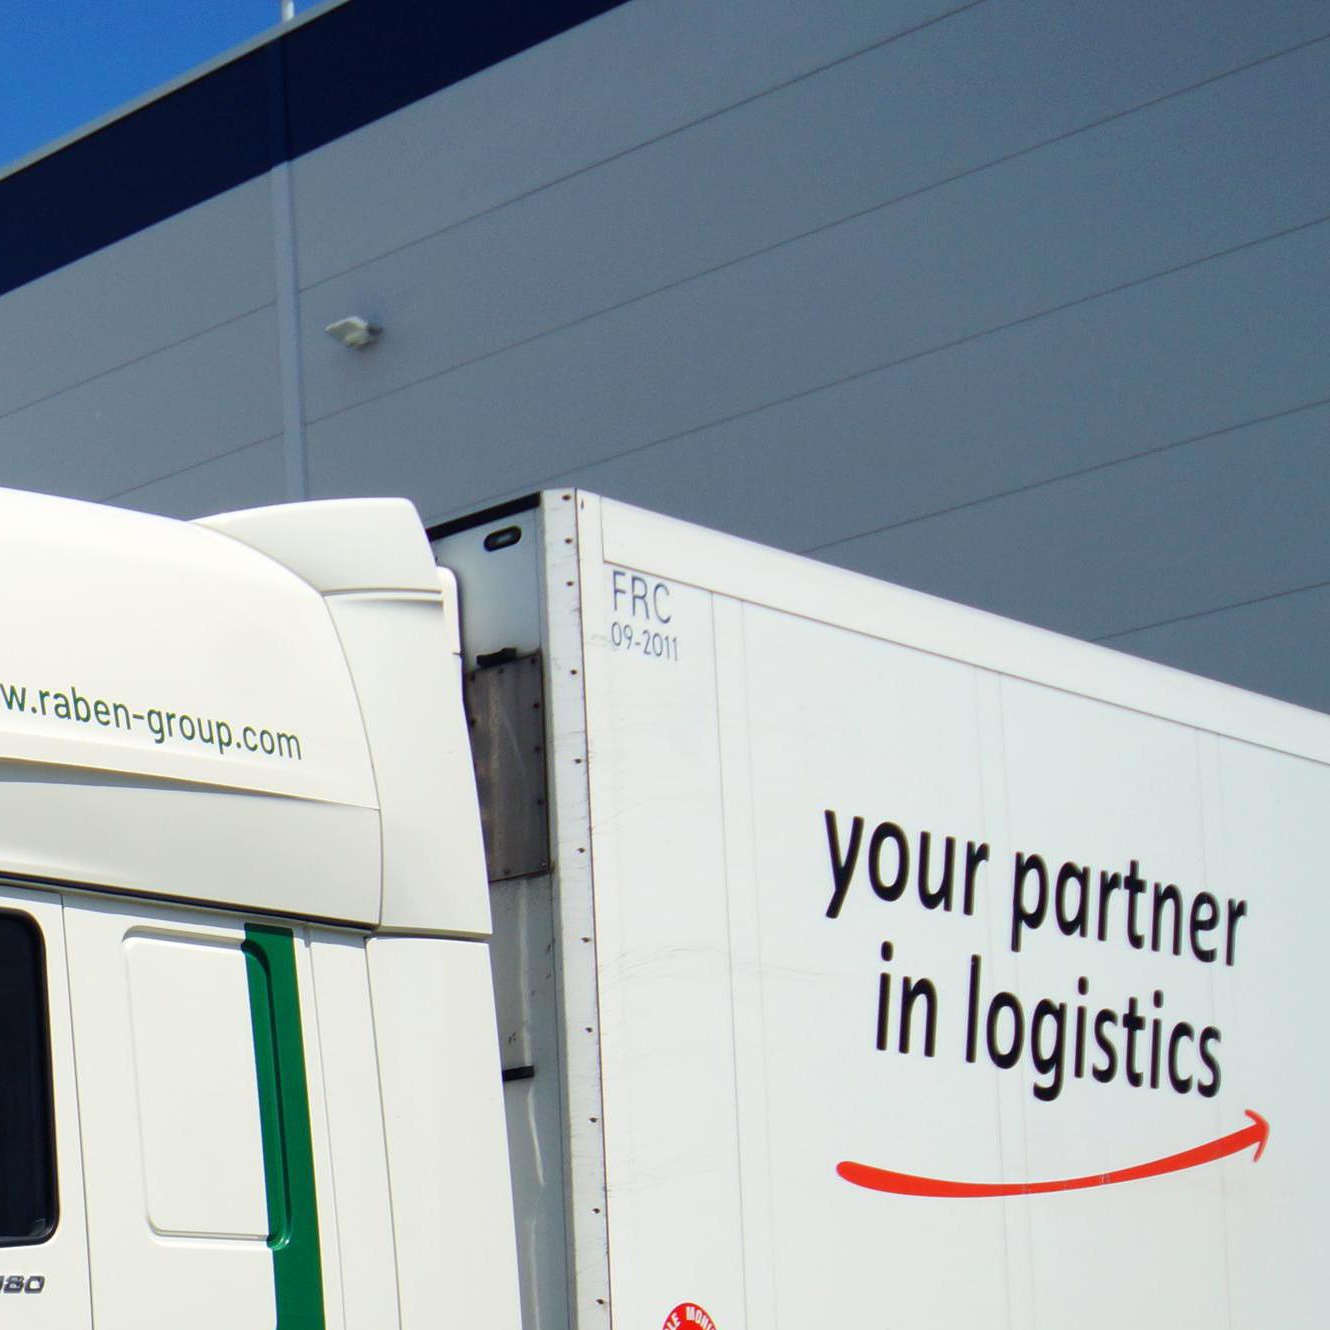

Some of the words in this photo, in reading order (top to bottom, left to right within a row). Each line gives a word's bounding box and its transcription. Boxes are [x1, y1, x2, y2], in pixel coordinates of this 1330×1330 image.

[611, 621, 679, 662] 09-2011
[612, 570, 672, 625] FRC
[823, 808, 991, 920] your
[1009, 850, 1249, 967] partner
[874, 940, 939, 1058] in
[964, 953, 1223, 1102] logistics
